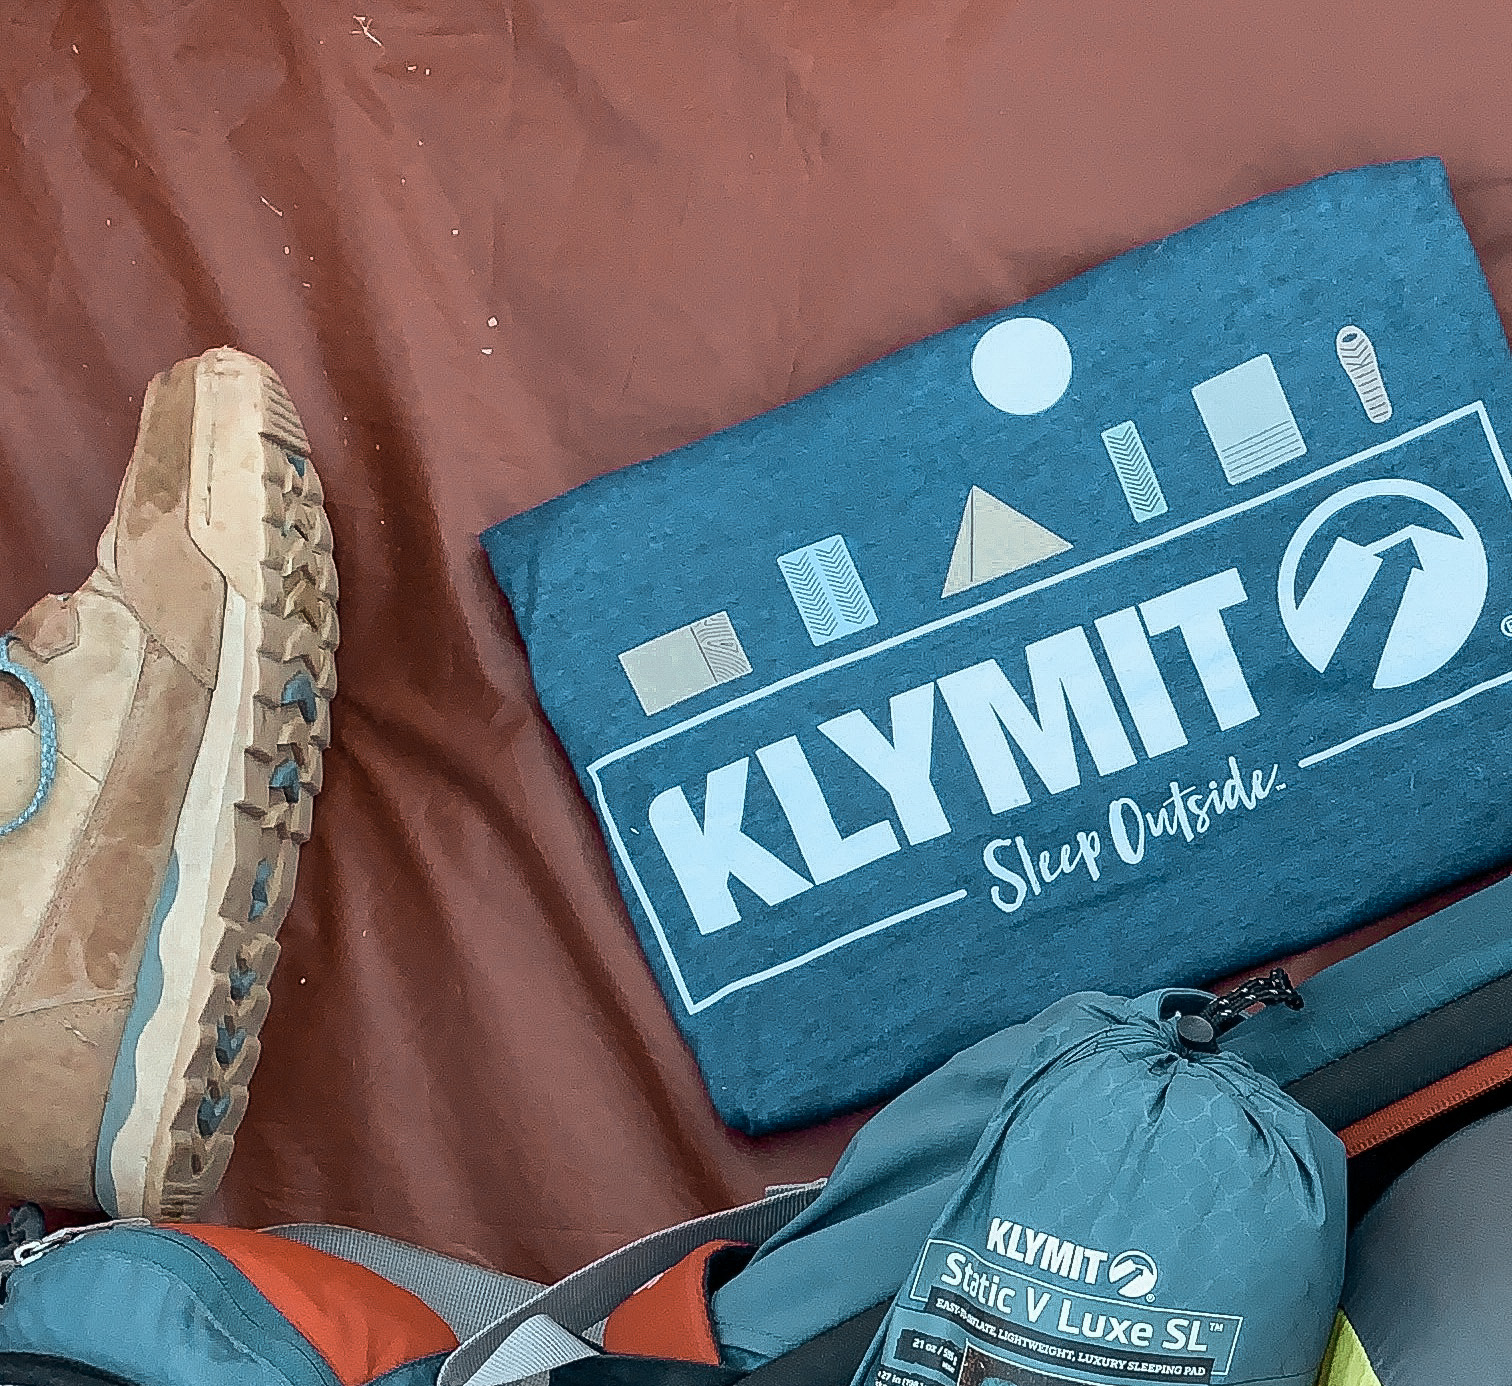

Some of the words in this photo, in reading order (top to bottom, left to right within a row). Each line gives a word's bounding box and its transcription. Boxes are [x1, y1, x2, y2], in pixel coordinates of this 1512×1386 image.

[648, 566, 1259, 936] KLYMIT
[983, 836, 1101, 913] Sleep
[986, 1217, 1109, 1285] KLYMIT
[941, 1252, 1016, 1314] Static
[1026, 1286, 1051, 1323] V
[1057, 1298, 1154, 1347] Luxe
[891, 1374, 902, 1385] in
[912, 1337, 925, 1349] 21
[925, 1343, 938, 1354] oz
[1077, 1351, 1129, 1370] LUXURY
[1126, 1360, 1182, 1376] SLEEPING
[1182, 1365, 1206, 1377] PAD
